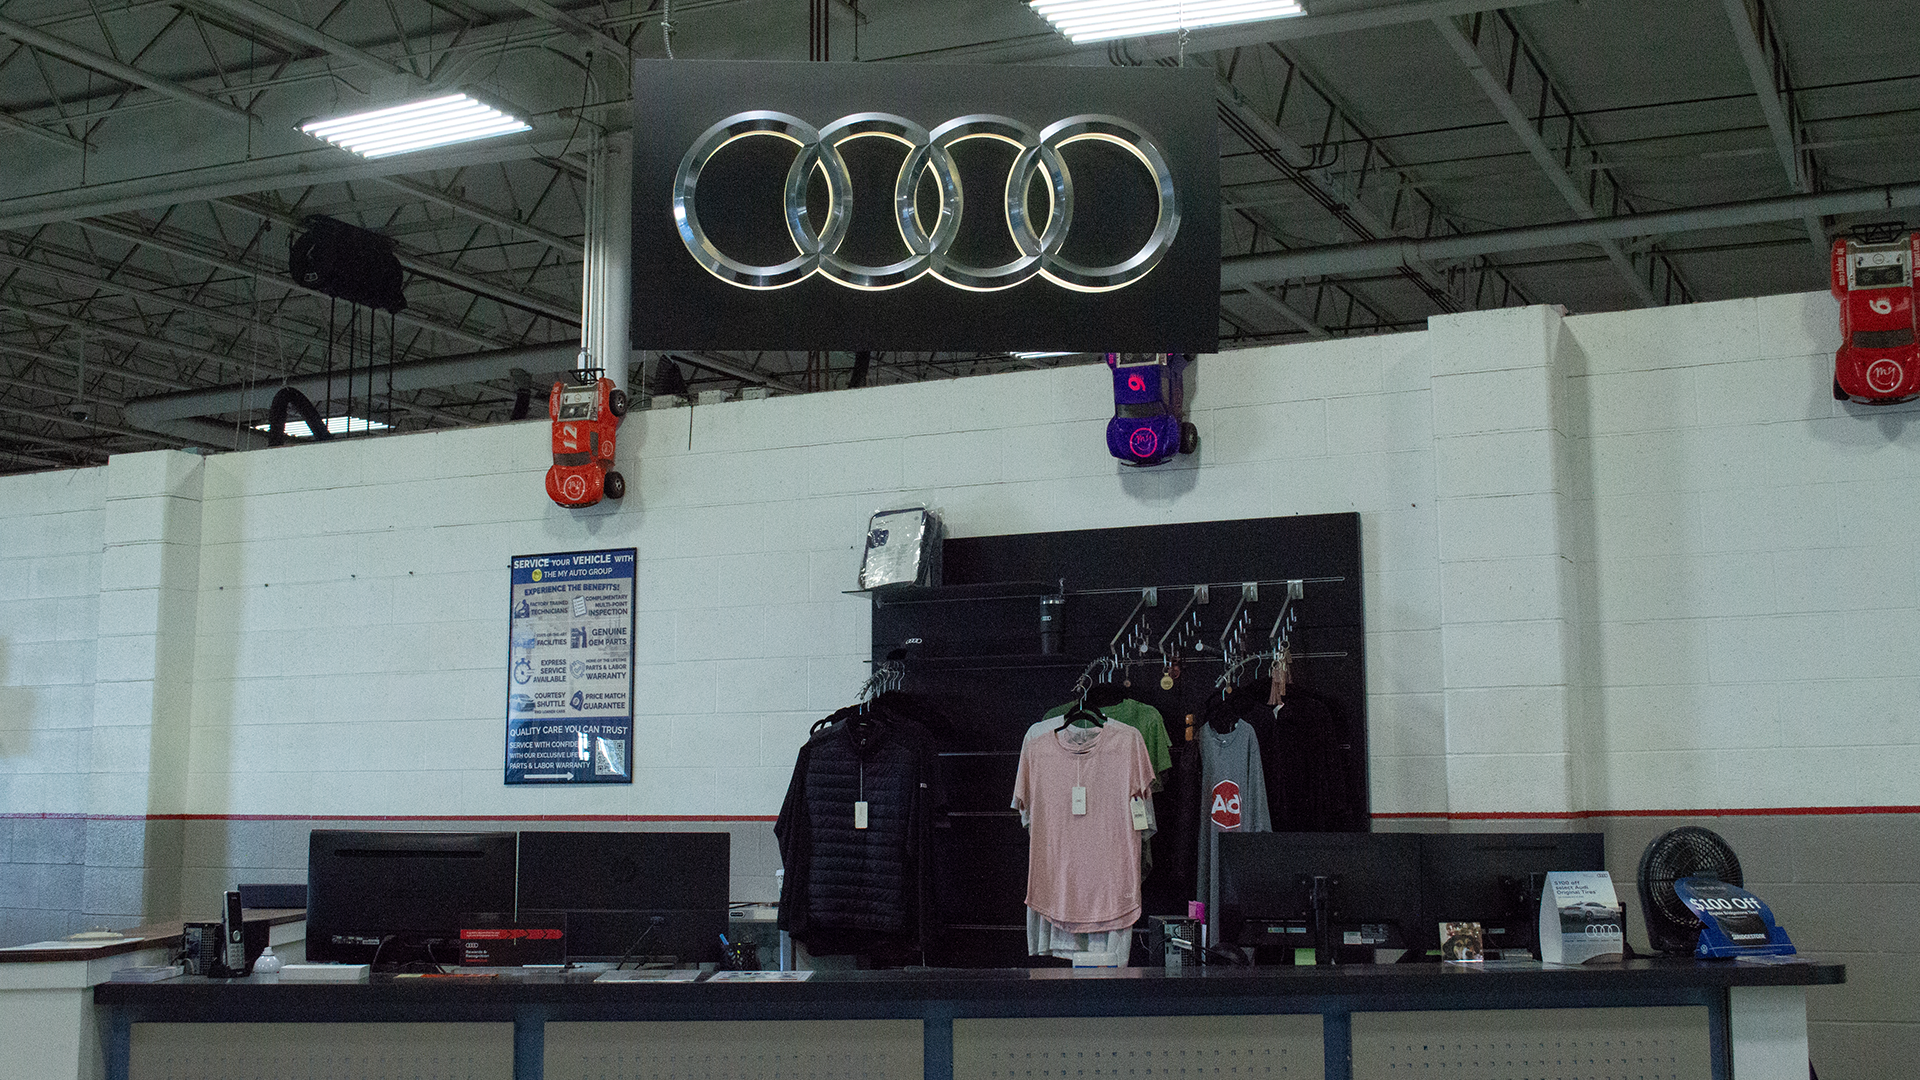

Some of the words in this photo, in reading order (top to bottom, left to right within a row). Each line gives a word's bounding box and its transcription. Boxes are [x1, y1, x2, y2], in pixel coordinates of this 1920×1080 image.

[562, 425, 578, 450] 12
[514, 558, 549, 569] SERVICE
[551, 559, 571, 567] YOUR
[572, 554, 612, 565] VEHICLE
[613, 554, 634, 563] WITH
[544, 570, 557, 578] THE
[568, 568, 588, 576] AUTO
[588, 567, 613, 576] GROUP
[524, 584, 567, 596] EXPERIENCE
[567, 583, 582, 592] THE
[583, 583, 620, 591] BENEFITS!
[530, 607, 569, 615] TECHNICIANS
[588, 608, 628, 616] INSPECTION
[591, 627, 628, 636] GENUINE
[536, 638, 568, 646] FACILITIES
[588, 639, 604, 647] OEM
[605, 637, 627, 646] PARTS
[541, 659, 567, 667] EXPRESS
[540, 666, 567, 675] SERVICE
[532, 675, 567, 683] AVAILABLE
[585, 671, 627, 680] WARRANTY
[534, 691, 567, 700] COURTESY
[585, 692, 603, 700] PRICE
[537, 700, 566, 708] SHUTTLE
[583, 701, 626, 710] GUARANTEE
[510, 726, 542, 737] QUALITY
[542, 725, 564, 734] CARE
[564, 724, 581, 733] YOU
[582, 724, 600, 733] CAN
[601, 725, 628, 735] TRUST
[510, 741, 534, 749] SERVICE
[551, 740, 591, 748] CONFIDEE
[537, 751, 566, 759] EXCLUSIVE
[510, 762, 528, 770] PARTS
[555, 761, 591, 769] WARRANTY
[1689, 897, 1733, 912] $100
[1731, 897, 1762, 909] Off
